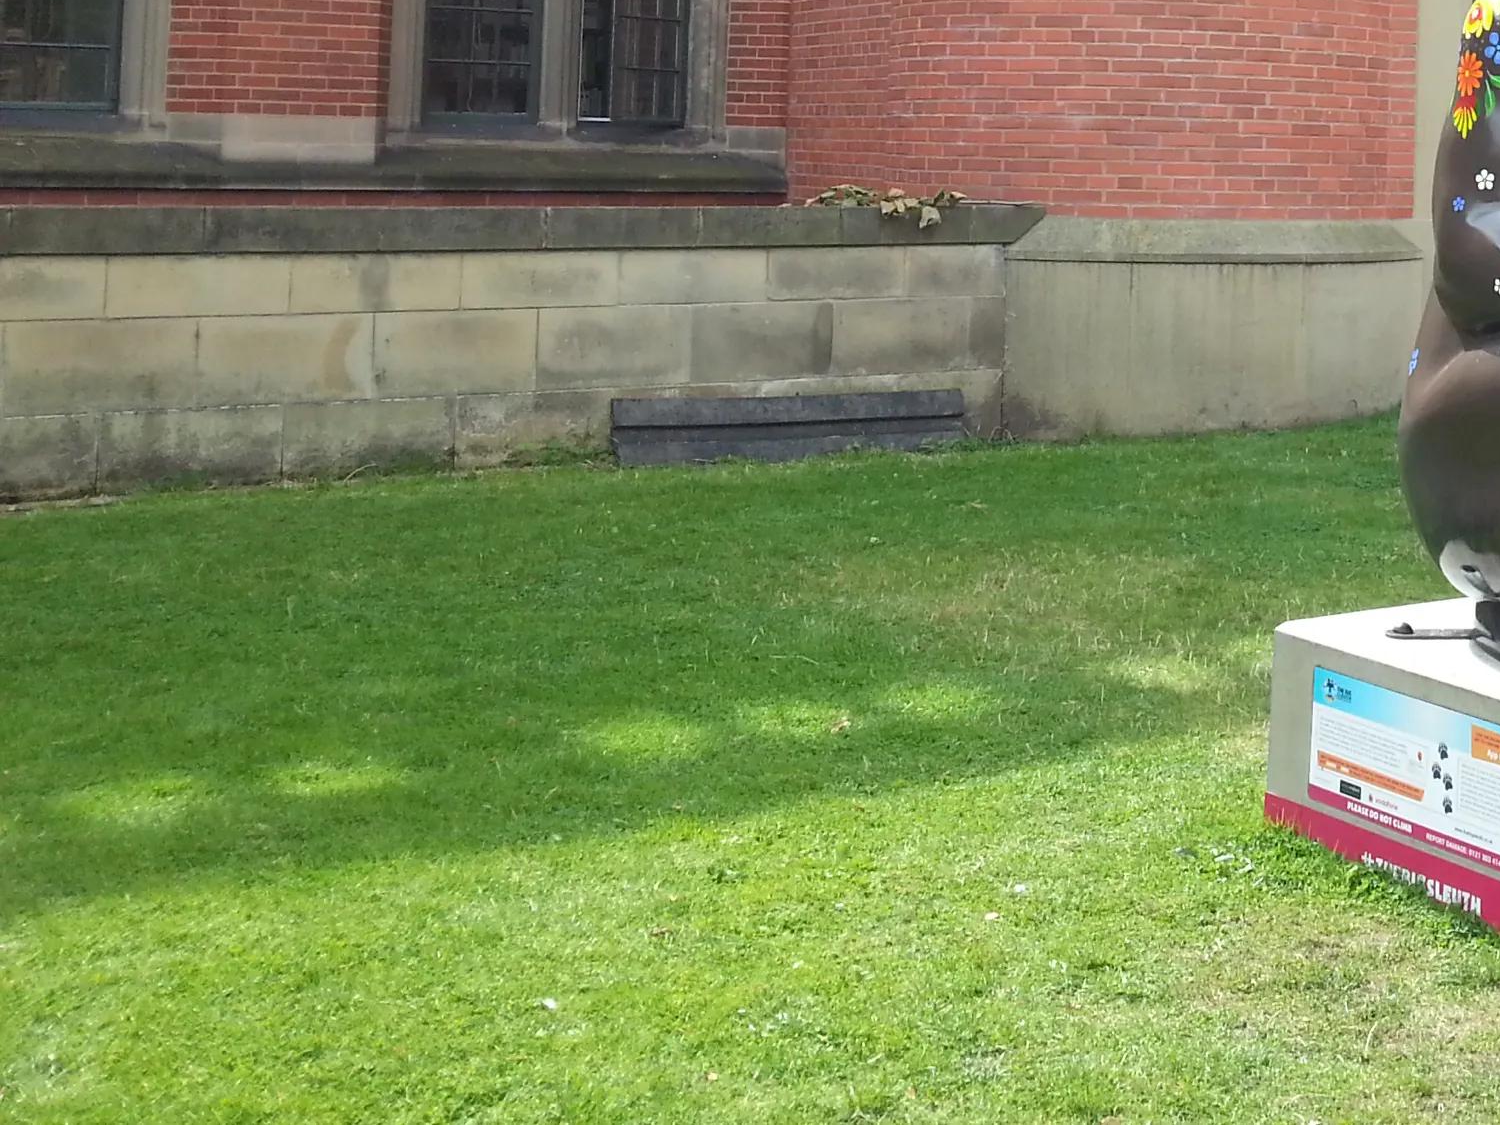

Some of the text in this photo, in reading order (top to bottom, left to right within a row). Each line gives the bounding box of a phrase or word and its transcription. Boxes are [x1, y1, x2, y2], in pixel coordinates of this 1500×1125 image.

[1347, 801, 1413, 834] PLEASE DO NOT CLIMB
